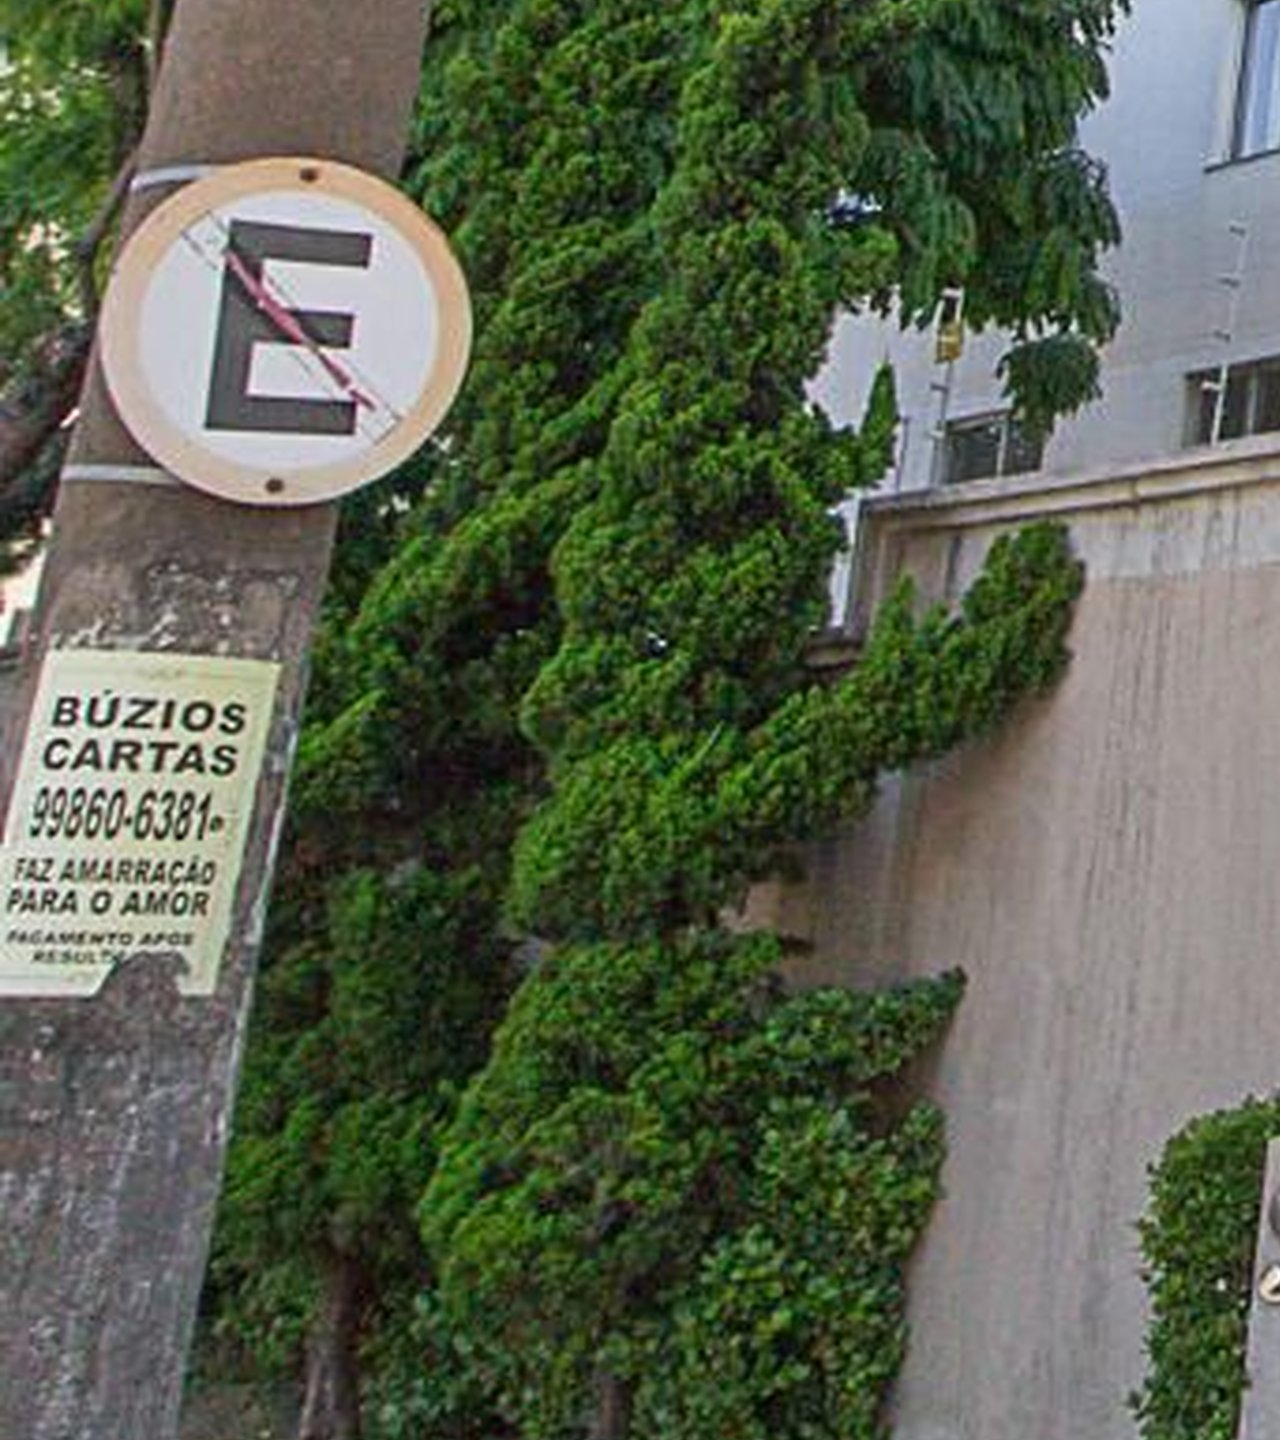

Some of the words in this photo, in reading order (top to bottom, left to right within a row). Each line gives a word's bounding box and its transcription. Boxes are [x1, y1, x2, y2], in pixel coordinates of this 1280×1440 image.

[205, 219, 372, 434] E
[51, 689, 247, 735] BÚZIOS
[42, 738, 239, 777] CARTAS
[13, 858, 54, 883] FAZ
[6, 889, 78, 915] PARA
[90, 890, 113, 915] O
[119, 891, 211, 916] AMOR
[6, 929, 135, 946] PAGAMENTO
